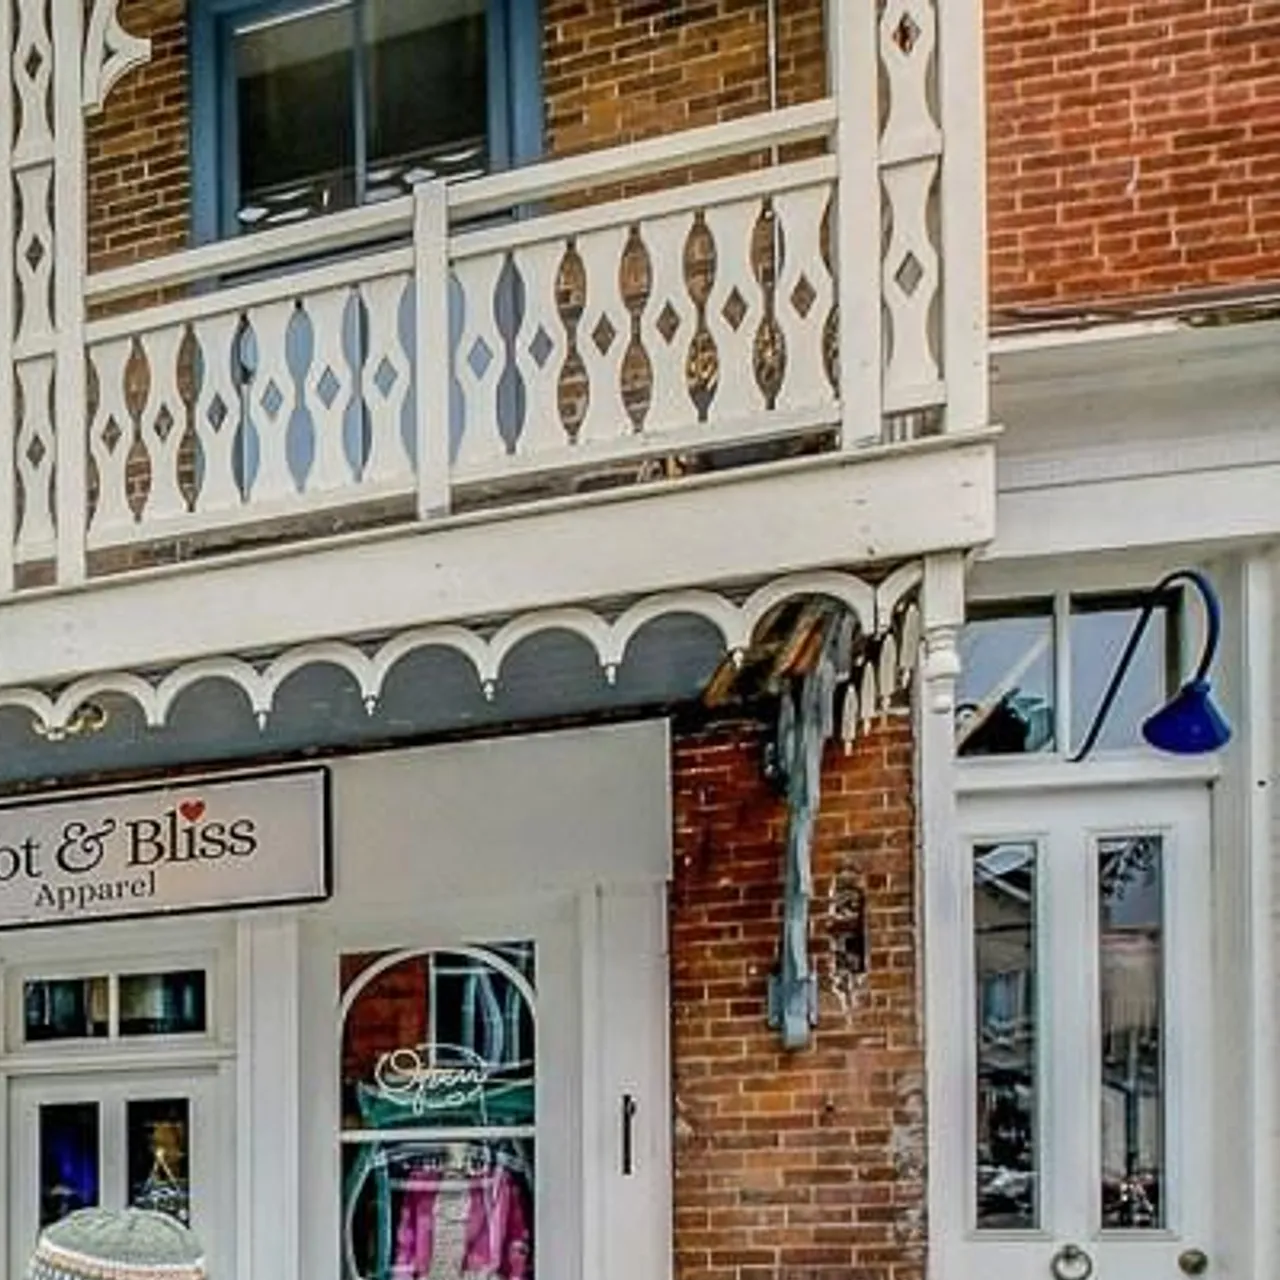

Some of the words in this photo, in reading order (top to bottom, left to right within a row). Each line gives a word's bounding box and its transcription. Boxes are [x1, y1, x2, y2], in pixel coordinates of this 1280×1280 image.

[56, 819, 116, 873] &
[127, 801, 257, 868] Bliss
[35, 871, 156, 910] Apparel
